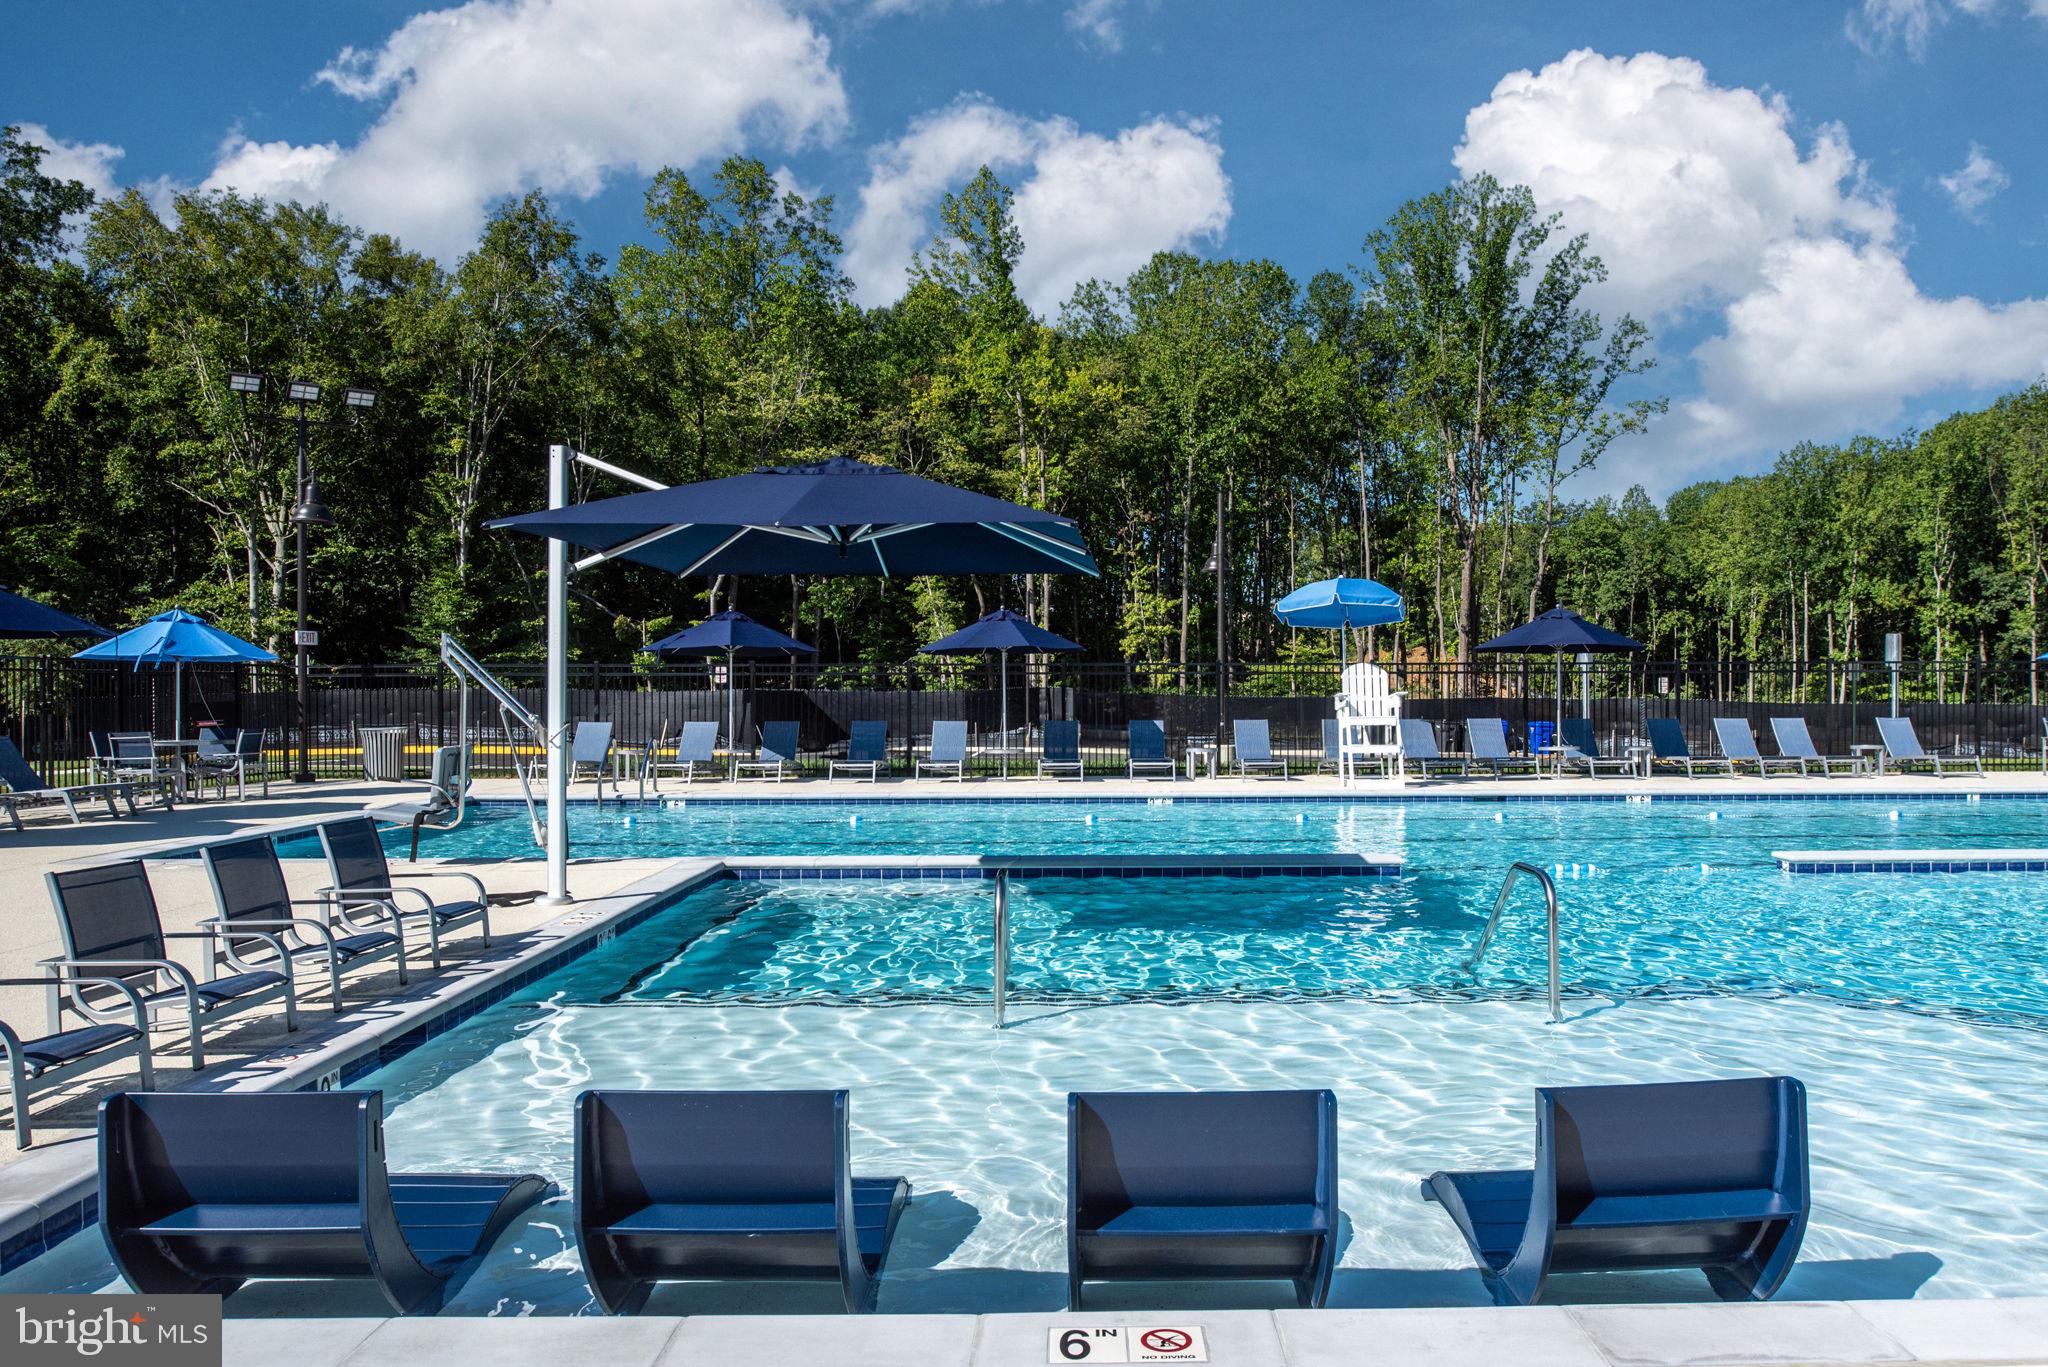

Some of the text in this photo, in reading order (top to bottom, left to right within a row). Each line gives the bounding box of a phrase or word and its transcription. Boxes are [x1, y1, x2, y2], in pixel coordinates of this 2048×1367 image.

[301, 632, 316, 644] EXIT
[1059, 1328, 1118, 1361] 6 IN
